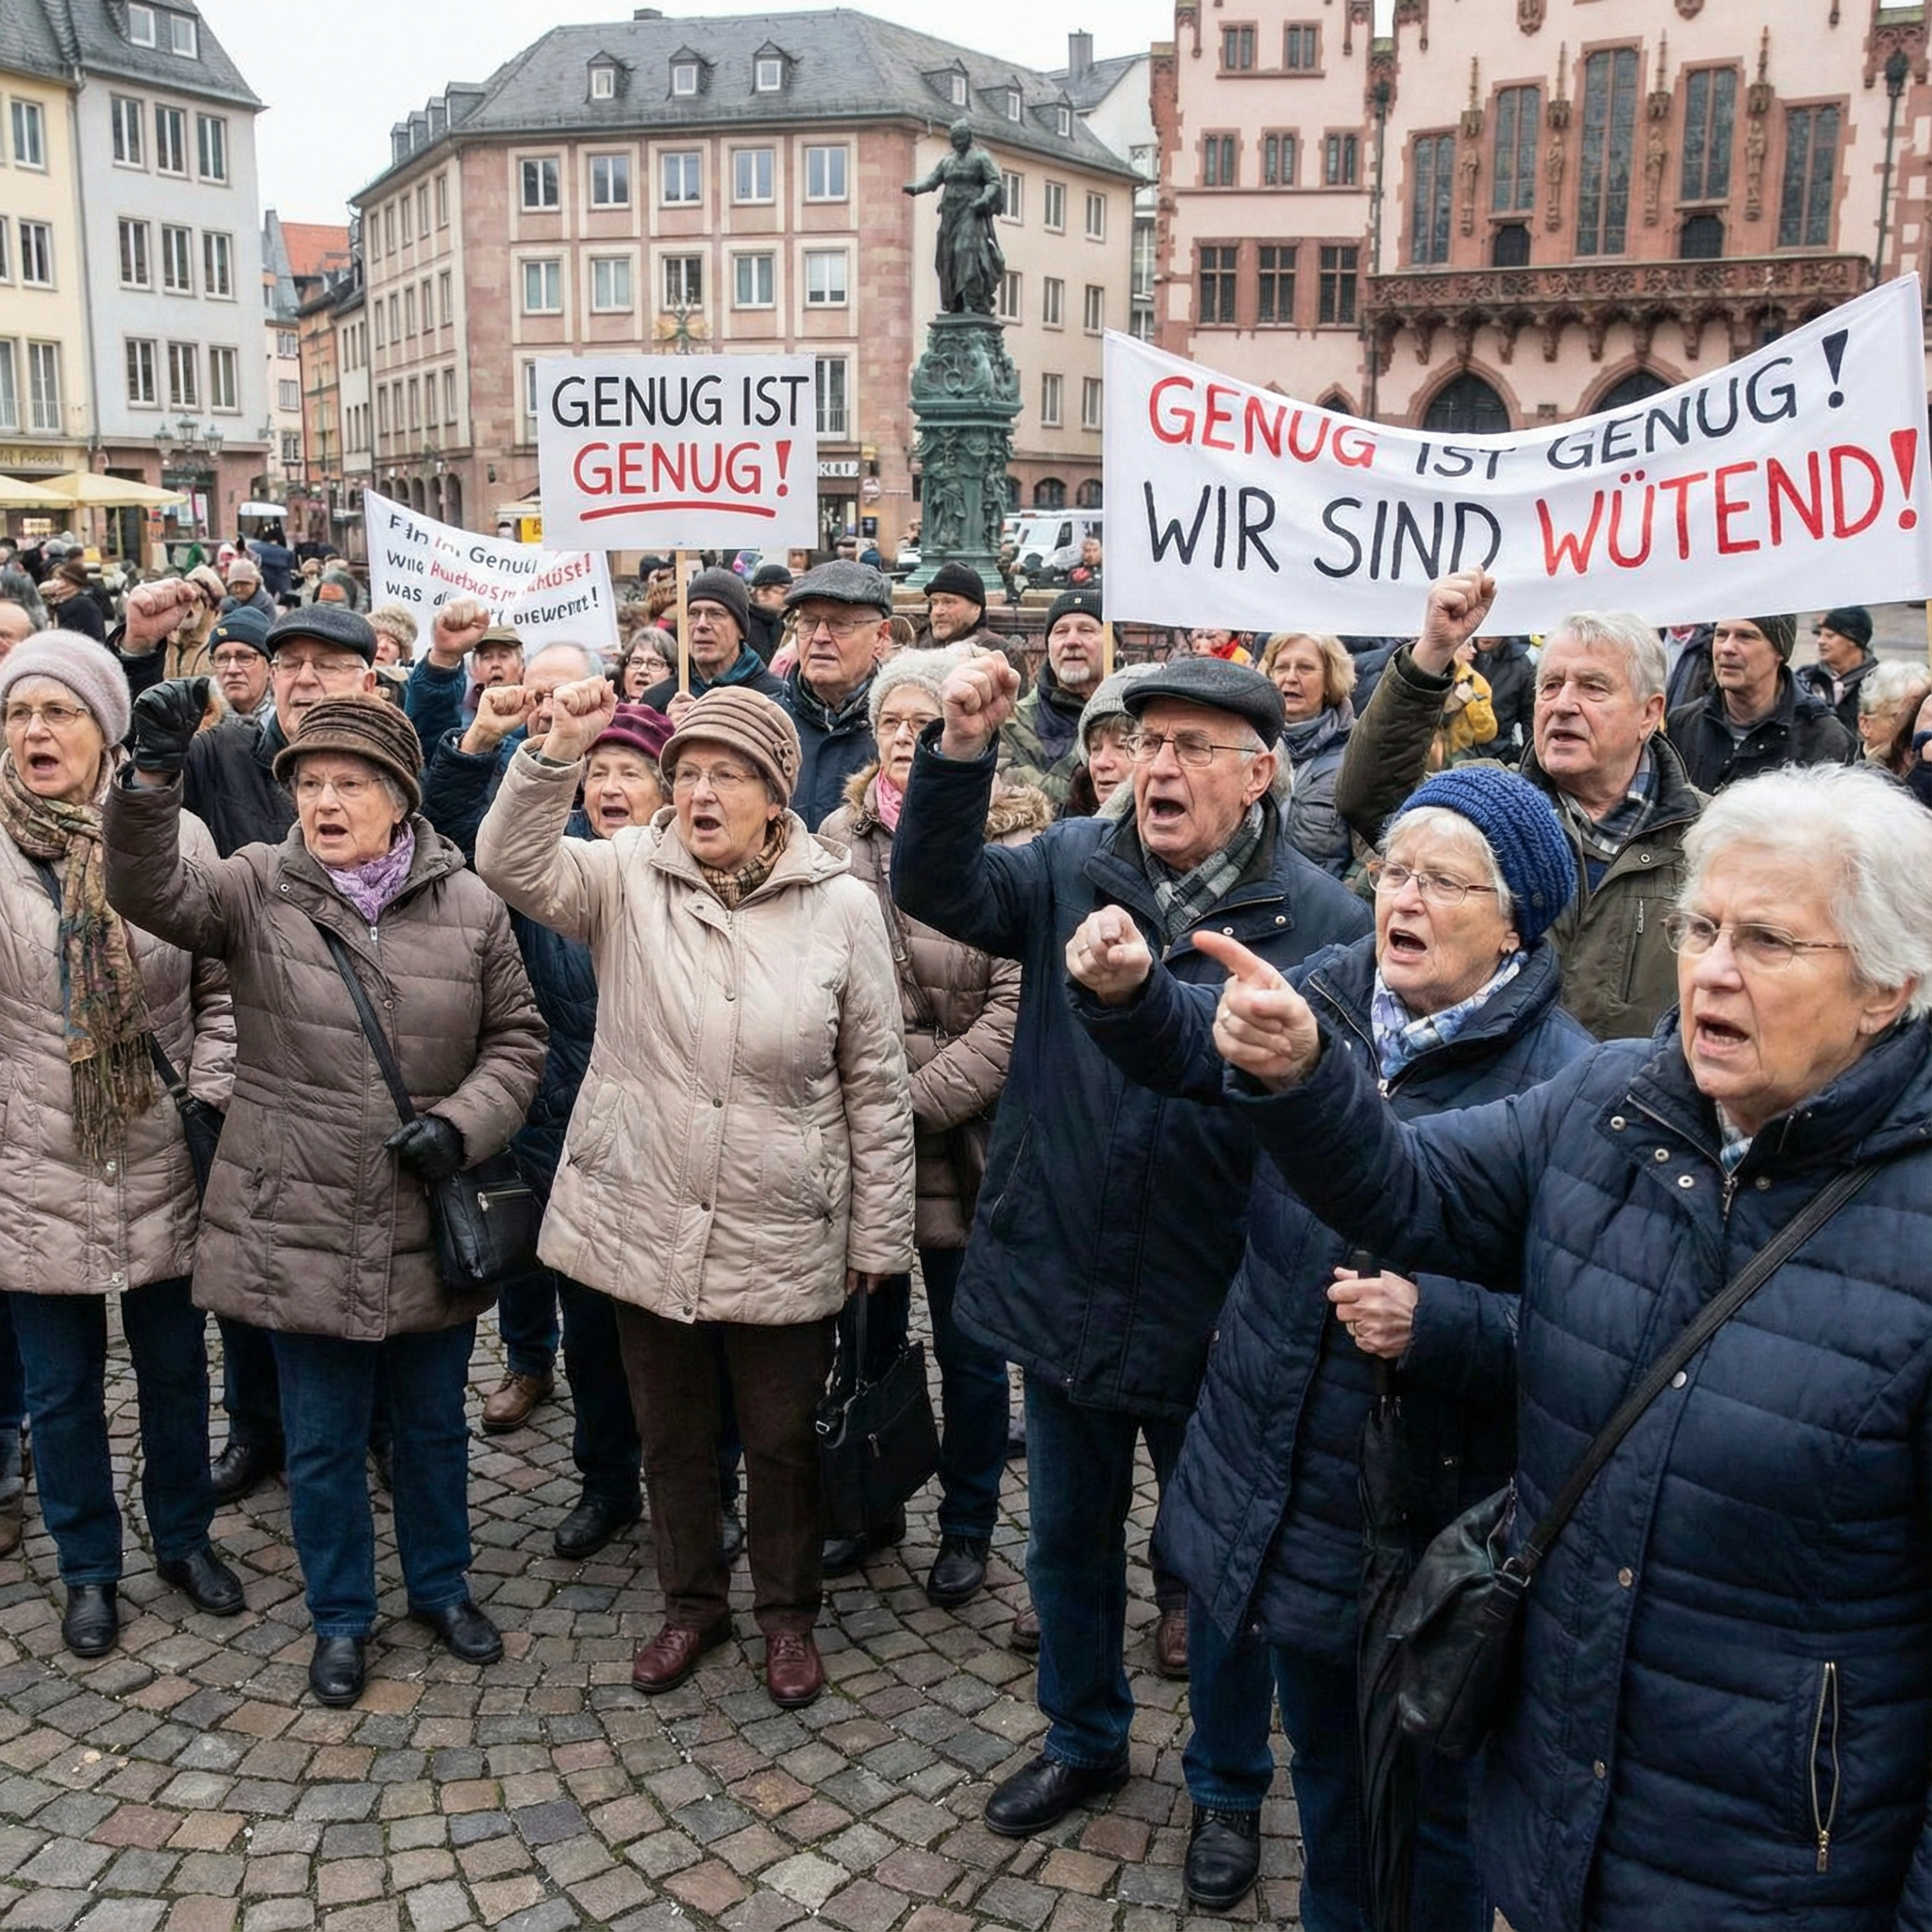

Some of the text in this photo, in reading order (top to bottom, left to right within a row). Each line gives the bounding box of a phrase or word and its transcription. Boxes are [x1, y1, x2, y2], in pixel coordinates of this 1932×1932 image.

[552, 375, 810, 428] GENUG IST
[1148, 375, 1379, 469] GENUG
[1416, 441, 1515, 482] IST
[573, 441, 792, 496] GENUG!
[1142, 427, 1920, 581] WIR SIND WÜTEND!
